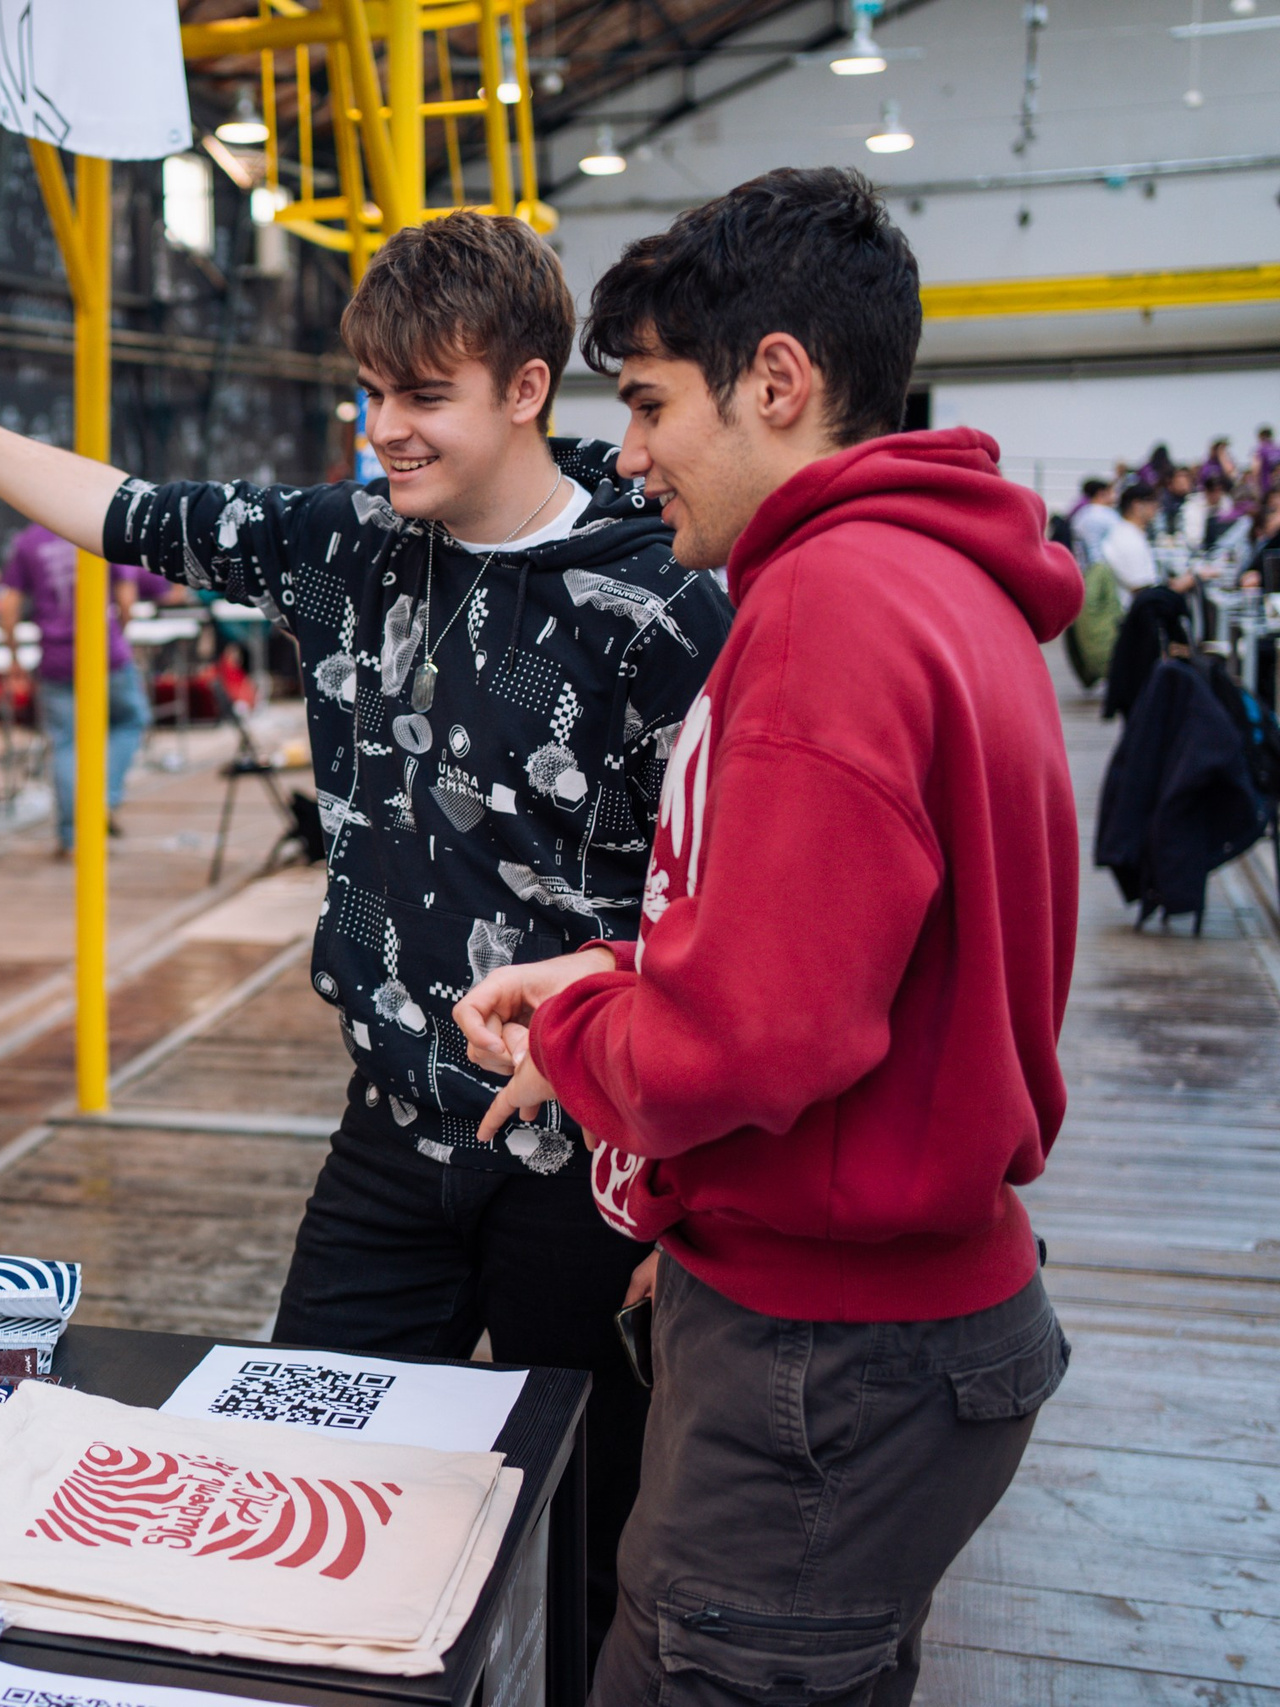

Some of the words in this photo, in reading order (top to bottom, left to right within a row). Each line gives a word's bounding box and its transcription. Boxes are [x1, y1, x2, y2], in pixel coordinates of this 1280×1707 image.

[438, 761, 479, 789] ULTRA
[437, 776, 493, 808] CHROME
[142, 1474, 226, 1549] Student
